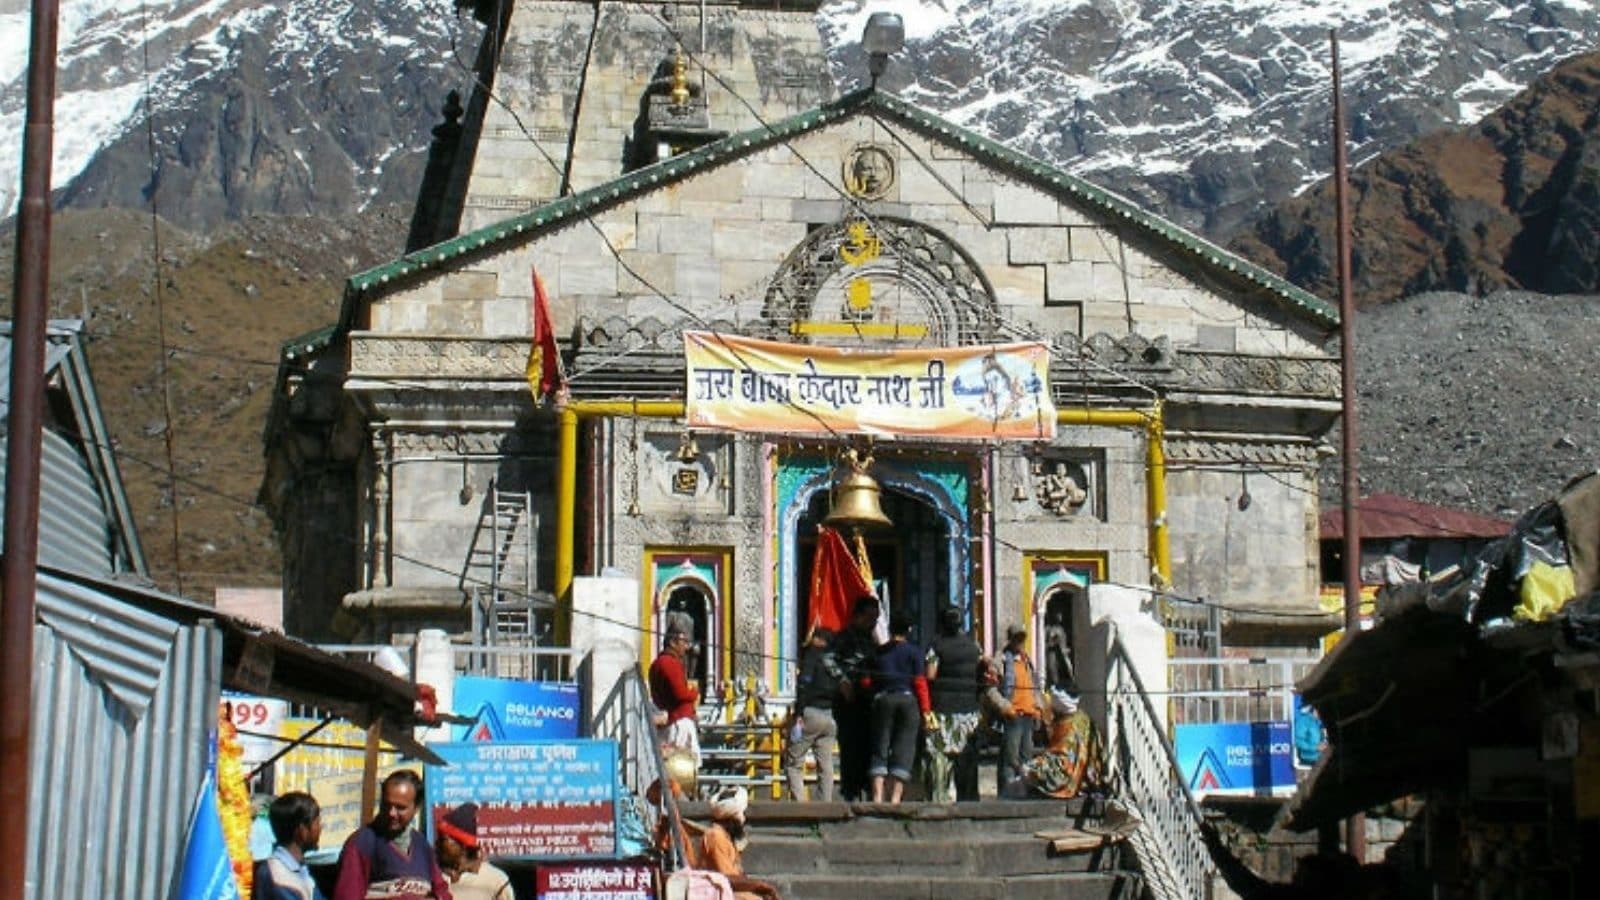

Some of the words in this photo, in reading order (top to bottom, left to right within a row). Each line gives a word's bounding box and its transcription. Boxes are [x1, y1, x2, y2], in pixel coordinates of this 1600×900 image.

[796, 358, 862, 409] केदार
[866, 375, 912, 407] नाथ
[917, 360, 946, 408] जी
